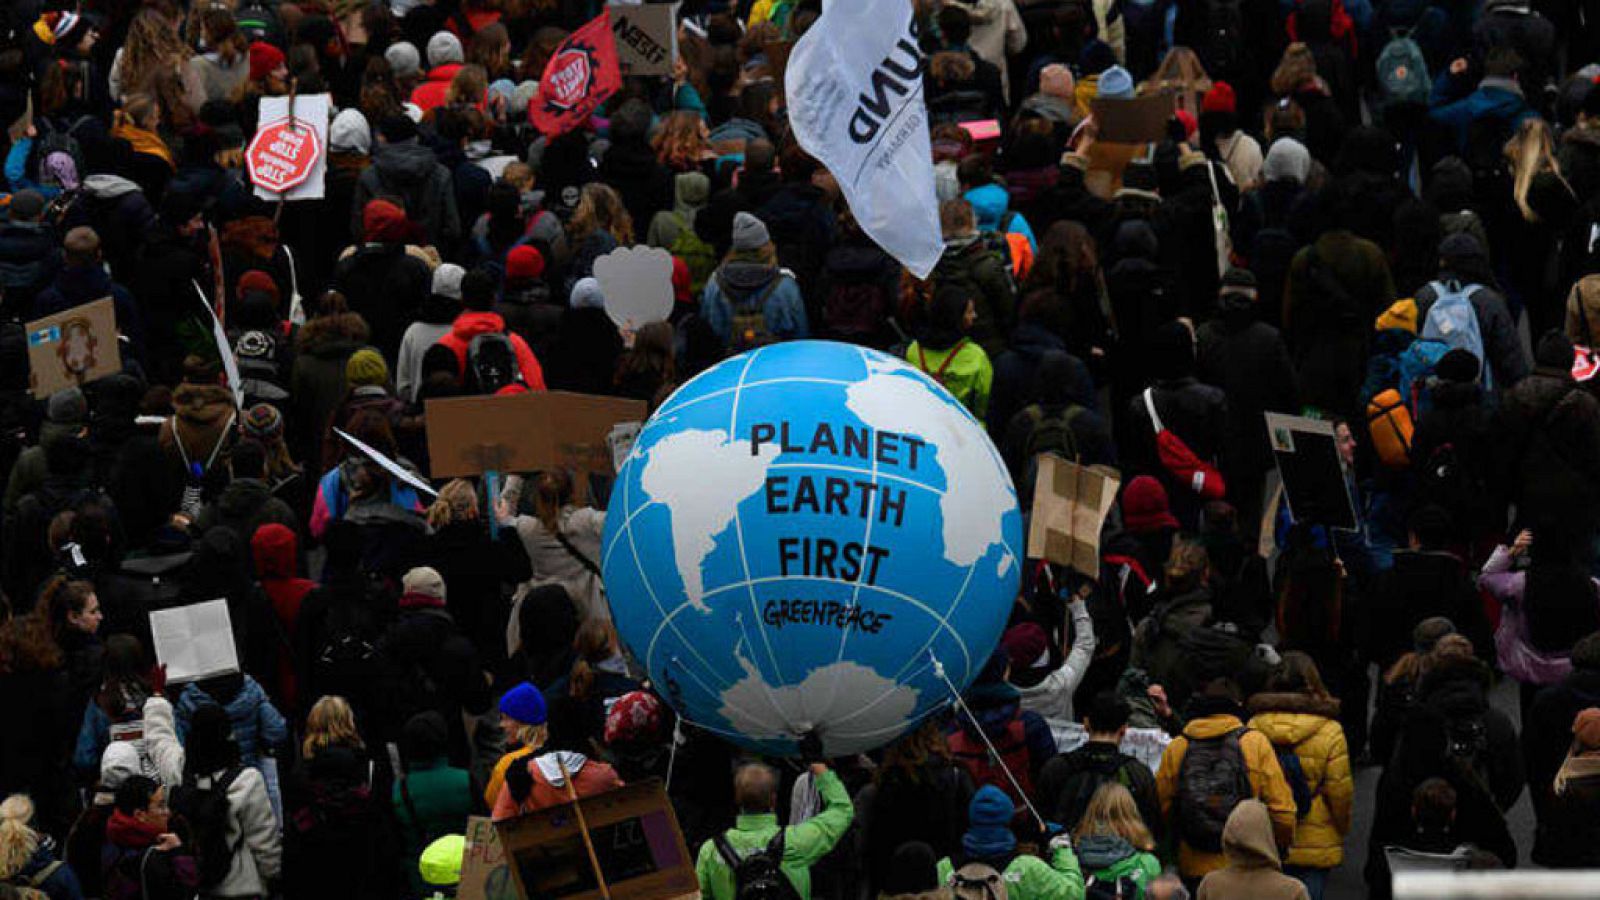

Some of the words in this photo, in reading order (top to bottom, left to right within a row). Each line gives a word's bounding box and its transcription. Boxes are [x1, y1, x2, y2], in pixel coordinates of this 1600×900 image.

[751, 421, 925, 470] PLANET
[766, 476, 907, 527] EARTH
[779, 537, 890, 586] FIRST
[763, 600, 893, 634] GREENPEACE
